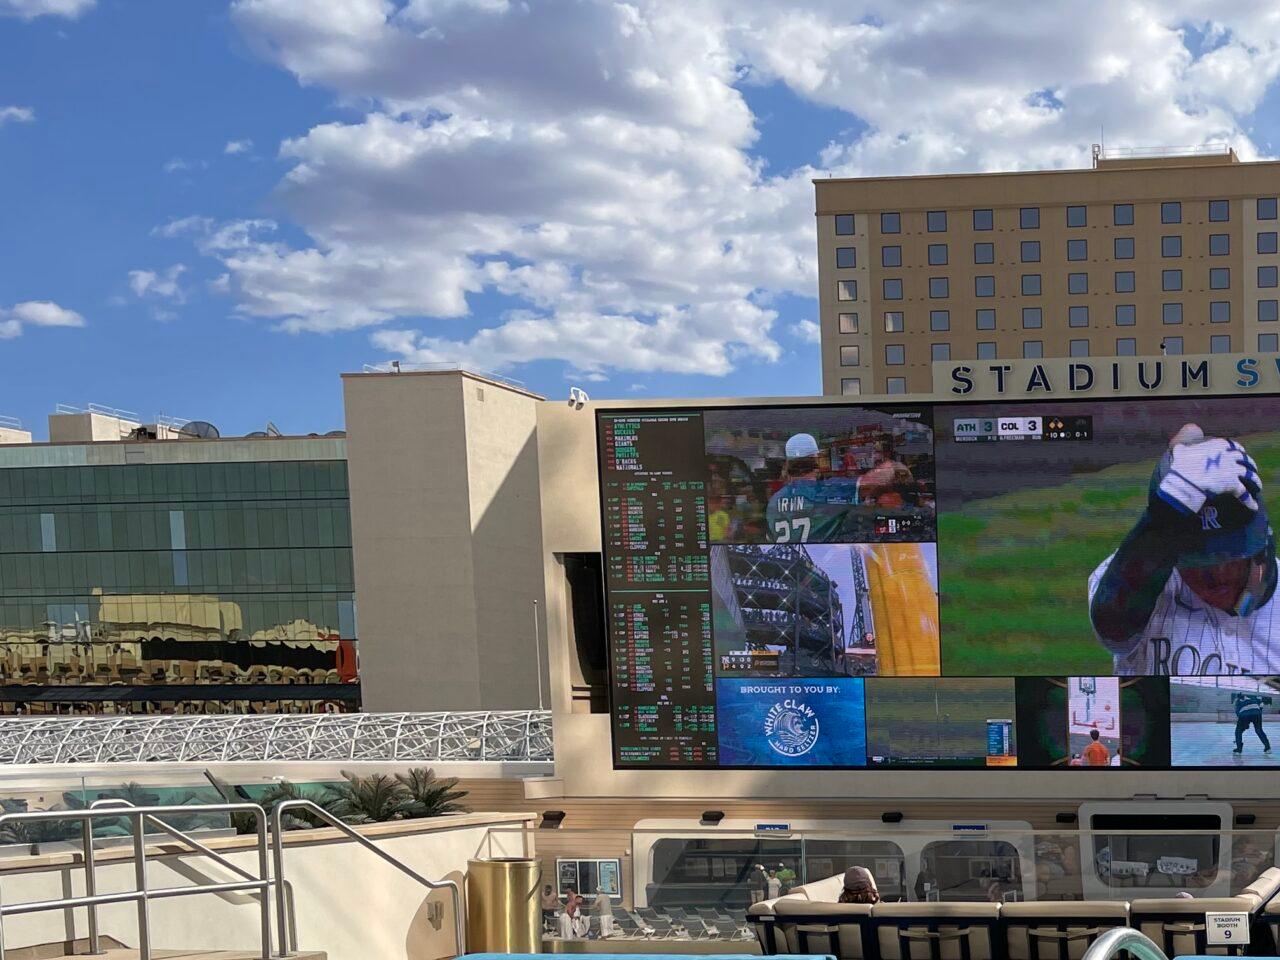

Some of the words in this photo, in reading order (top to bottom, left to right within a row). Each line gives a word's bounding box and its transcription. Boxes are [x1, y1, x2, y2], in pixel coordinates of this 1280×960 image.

[951, 360, 1209, 394] STADIUM
[957, 423, 976, 432] ATH
[984, 421, 993, 432] 3
[1001, 422, 1019, 431] COL
[1028, 420, 1037, 431] 3
[740, 686, 786, 694] BROUGHT
[763, 703, 784, 736] WHITE
[784, 700, 815, 718] CLAW
[774, 741, 795, 753] HARD
[796, 725, 816, 752] SELTZER
[1224, 930, 1232, 939] 9
